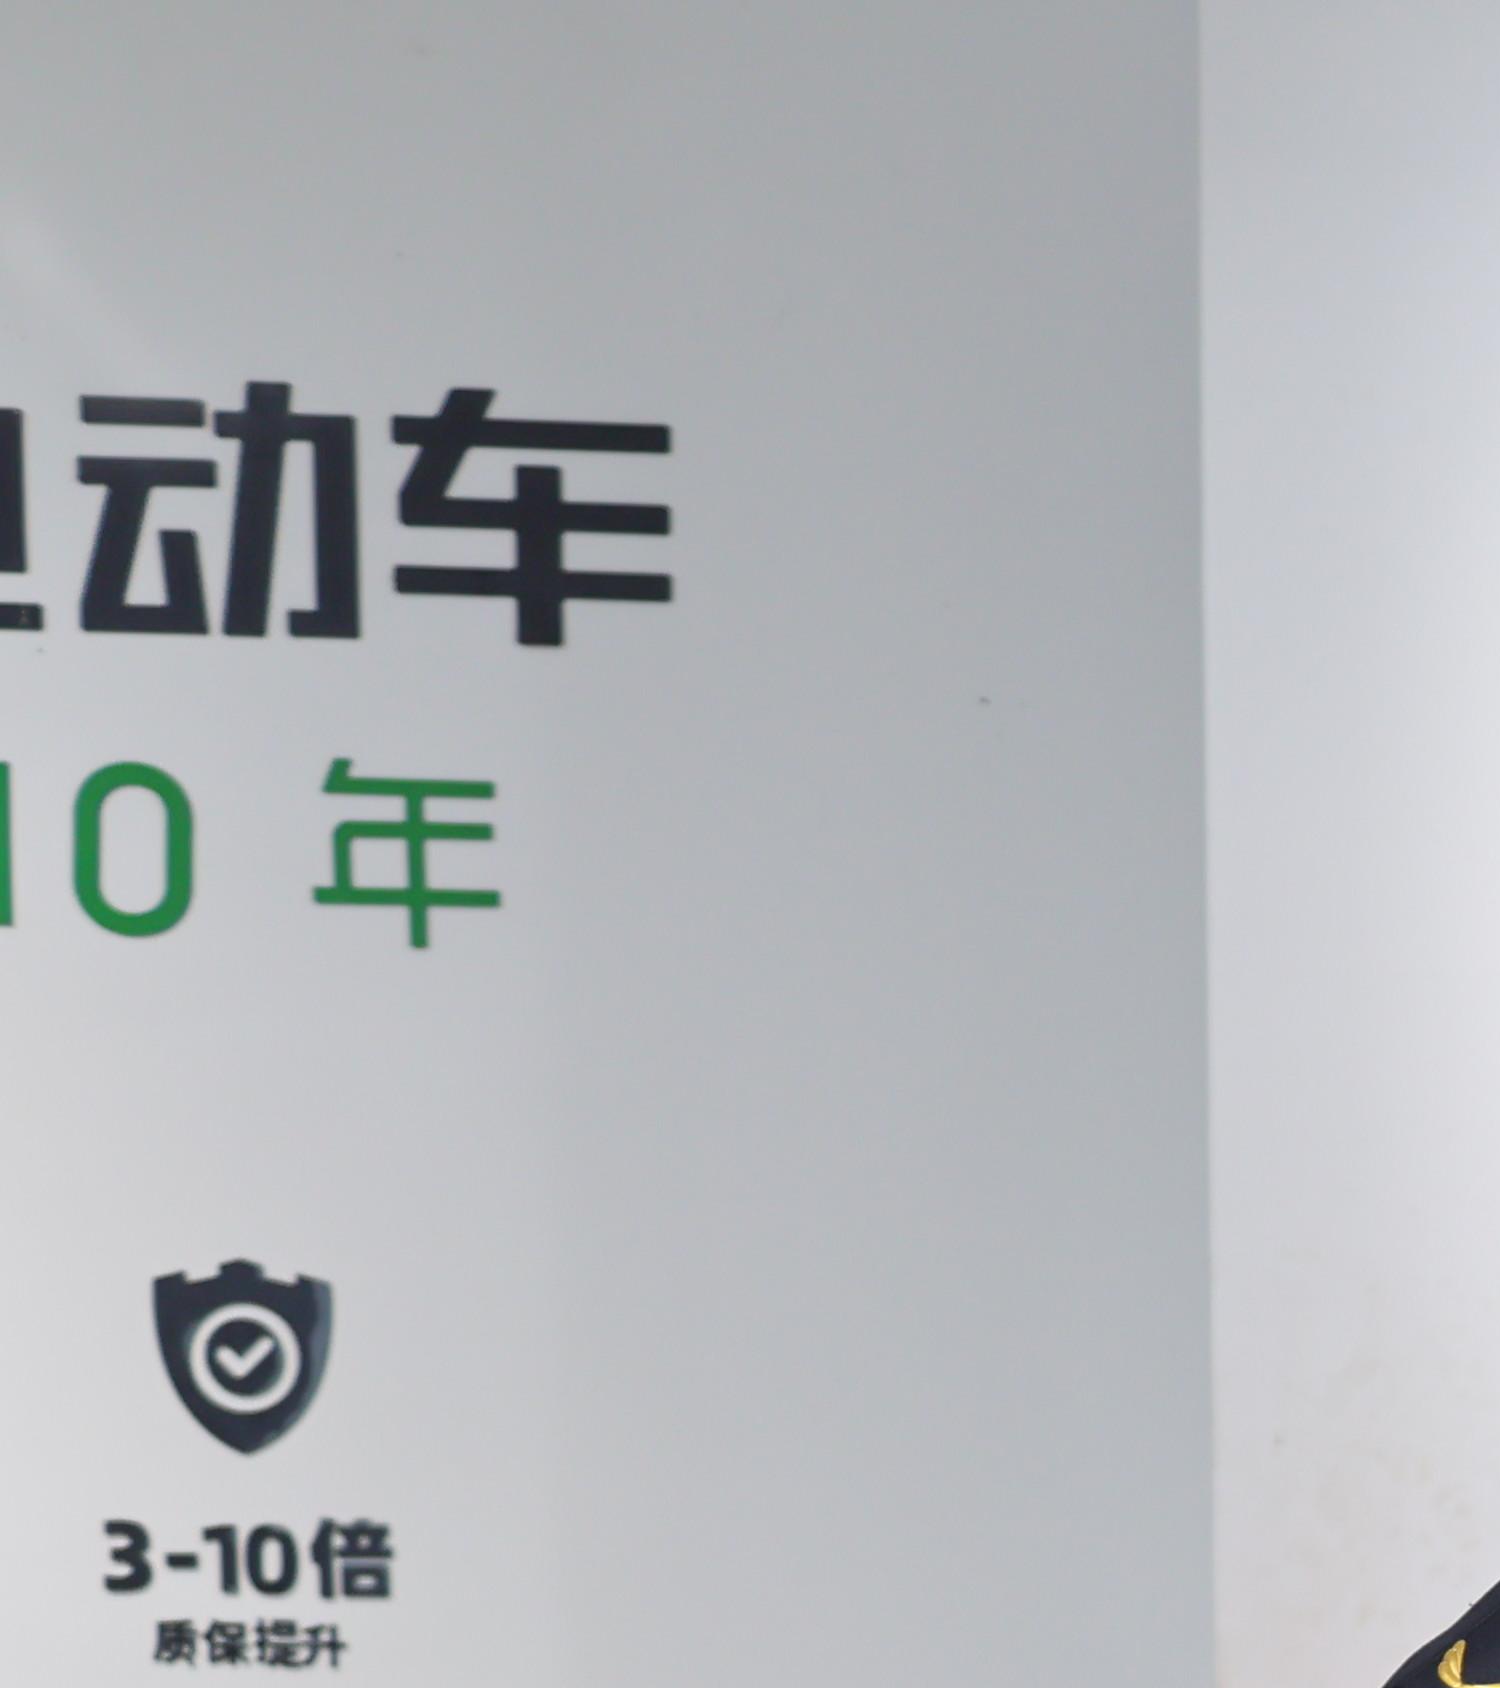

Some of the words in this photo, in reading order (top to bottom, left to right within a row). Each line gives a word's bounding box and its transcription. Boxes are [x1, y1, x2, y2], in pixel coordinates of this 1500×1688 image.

[0, 381, 672, 646] 动车
[103, 1518, 393, 1600] 3-10倍
[152, 1618, 346, 1669] 质保提升
